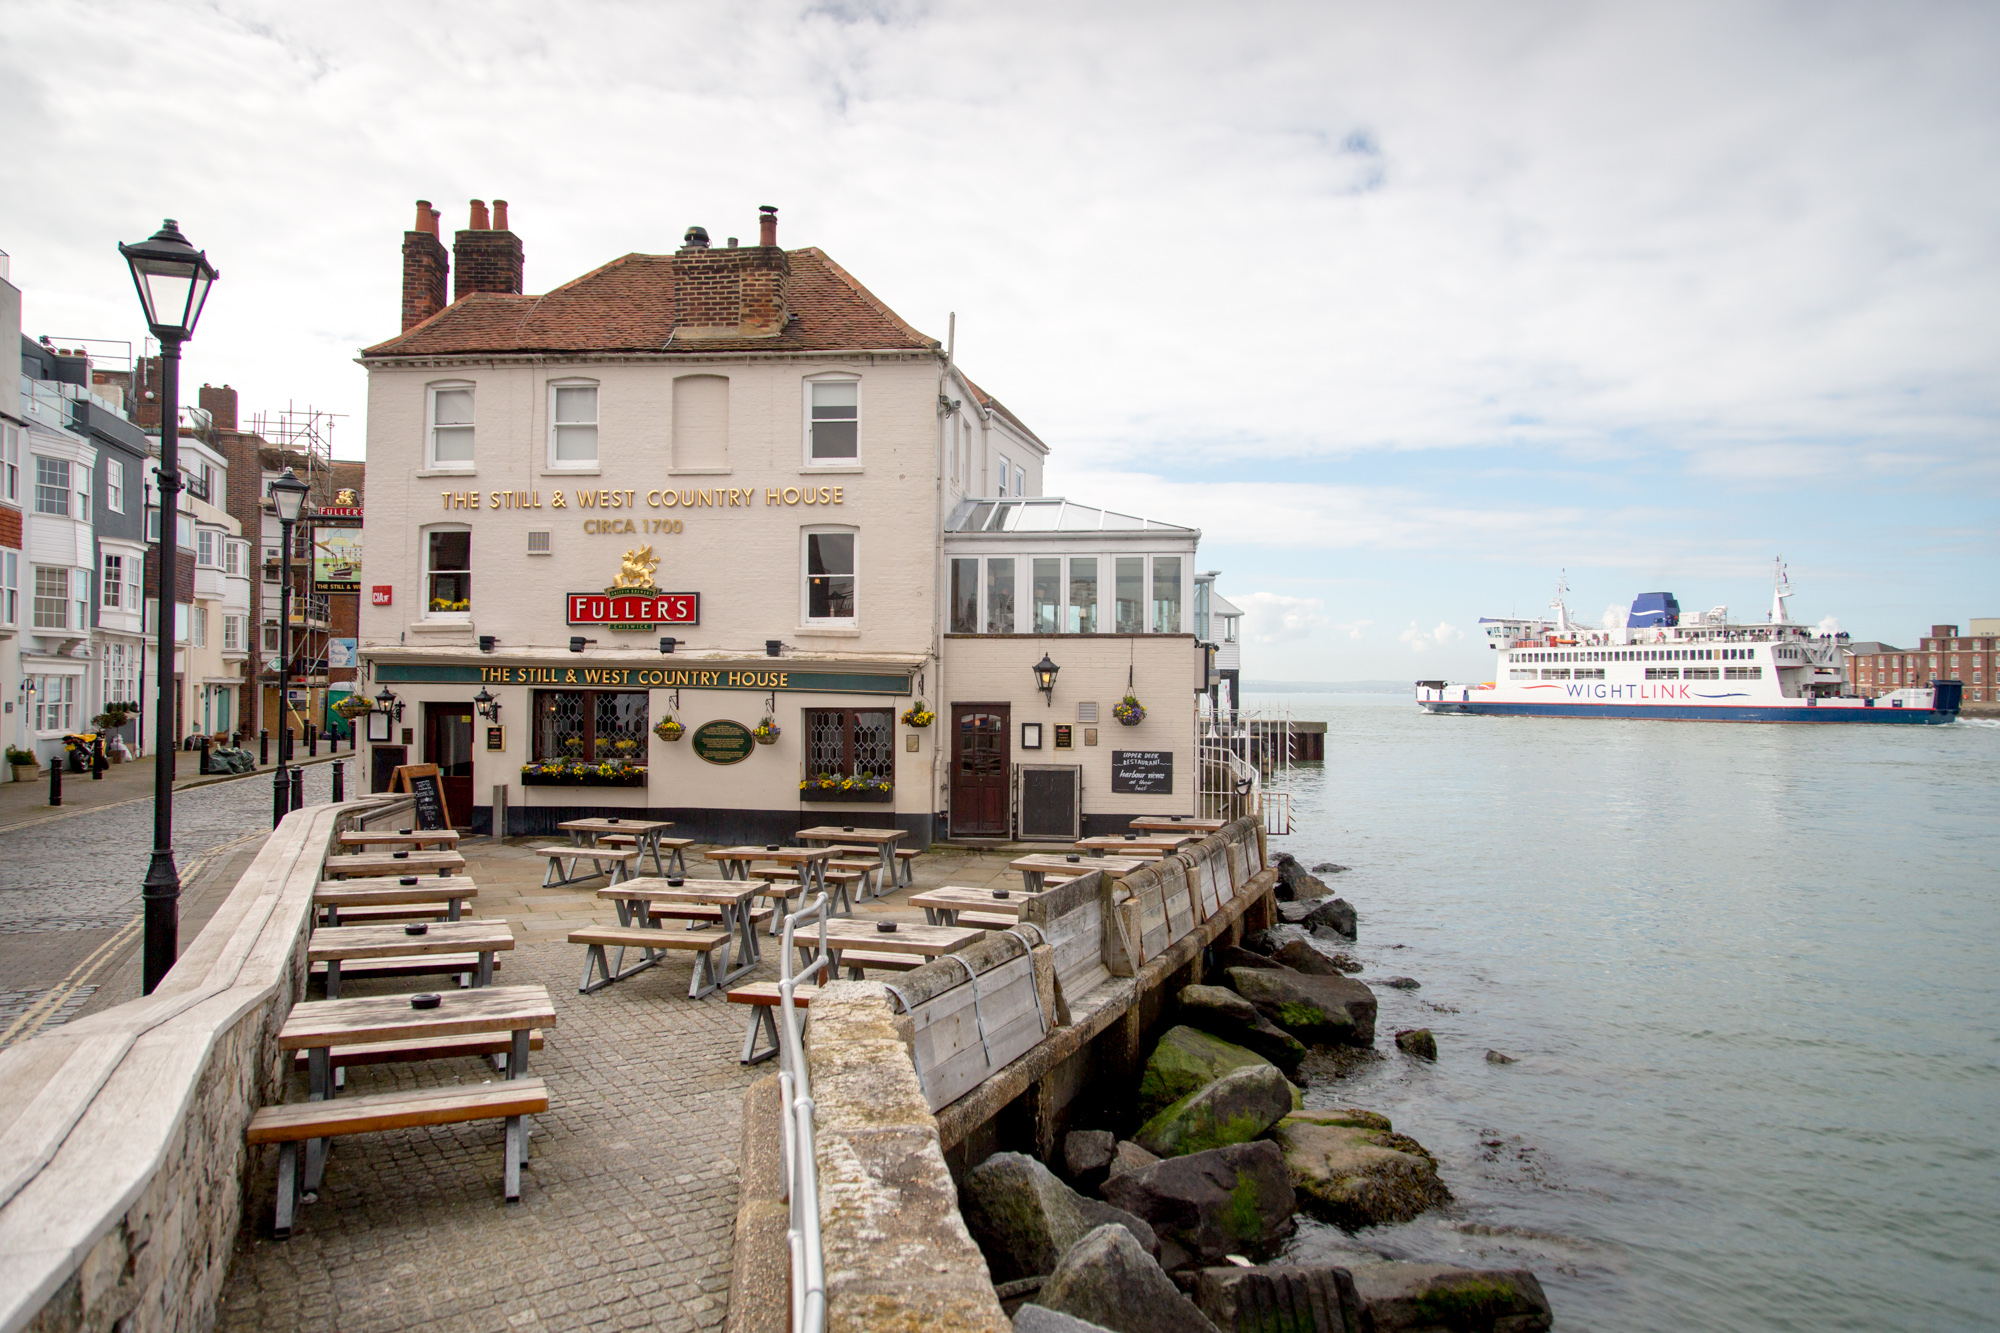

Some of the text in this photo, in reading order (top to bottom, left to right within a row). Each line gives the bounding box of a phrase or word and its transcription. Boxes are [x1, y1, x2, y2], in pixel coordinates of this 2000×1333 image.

[441, 486, 844, 509] THE STILL & WEST COUNTRY HOUSE
[583, 518, 683, 534] CIRCA 1700
[575, 597, 688, 620] FULLER'S
[480, 667, 789, 688] THE STILL & WEST COUNTRY HOUSE
[1566, 684, 1691, 699] WIGHTLINK
